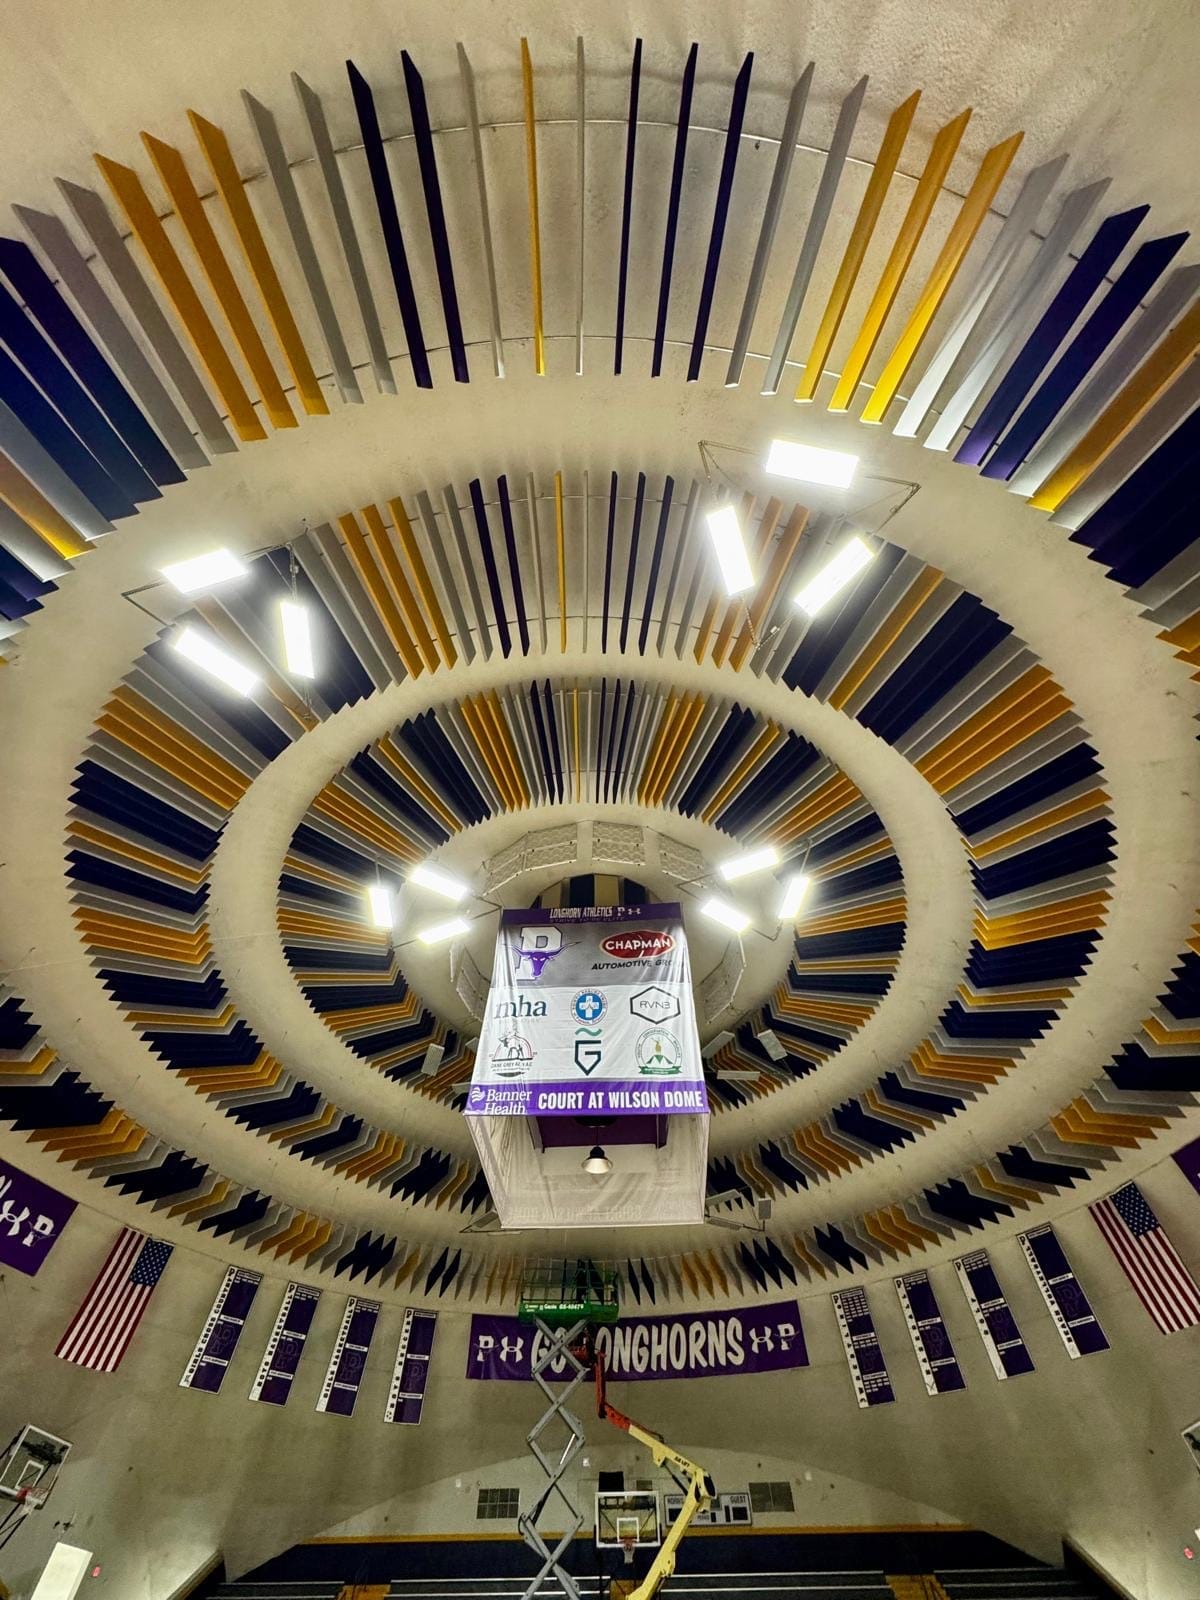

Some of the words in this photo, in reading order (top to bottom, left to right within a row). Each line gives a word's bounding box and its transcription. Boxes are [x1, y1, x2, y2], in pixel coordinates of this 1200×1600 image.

[550, 907, 581, 919] LONGHORN
[582, 906, 613, 918] ATHLETICS
[605, 938, 671, 950] CHAPMAN
[591, 960, 652, 971] AUTOMOTIVE
[494, 994, 548, 1019] mha
[484, 1102, 526, 1115] Health
[486, 1089, 532, 1102] Banner
[538, 1091, 584, 1110] COURT
[589, 1091, 606, 1108] AT
[608, 1090, 660, 1109] WILSON
[664, 1090, 702, 1107] DOME
[1025, 1246, 1056, 1306] VOLLEYBALL
[188, 1347, 204, 1375] GIRLS
[201, 1316, 216, 1345] CROSS
[213, 1277, 233, 1315] COUNTRY
[970, 1296, 989, 1336] GOLF
[1054, 1310, 1073, 1343] BEACH
[257, 1361, 269, 1387] BOYS
[267, 1293, 293, 1356] BASKETBALL
[594, 1317, 745, 1373] ONGHORNS
[836, 1304, 865, 1394] WRESTLING
[901, 1294, 931, 1376] BASEBALL
[323, 1369, 335, 1399] GIRLS
[332, 1308, 353, 1366] BASKETBALL
[389, 1375, 400, 1409] BOYS
[398, 1320, 410, 1366] SOCCER
[730, 1496, 746, 1504] GUEST
